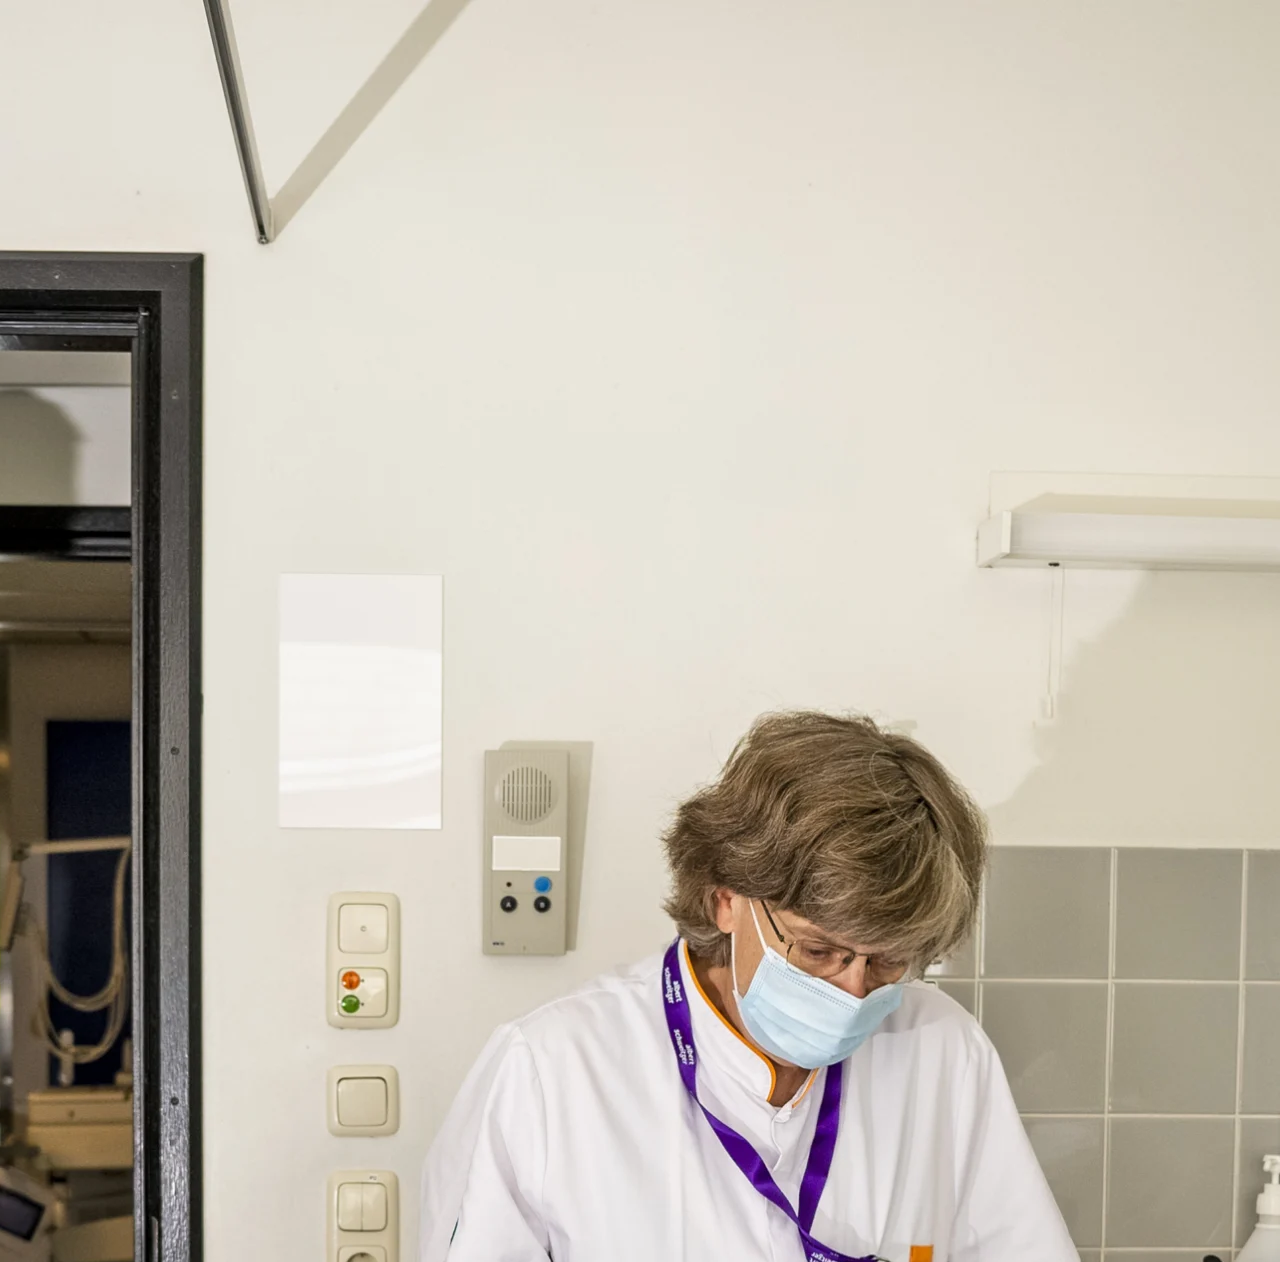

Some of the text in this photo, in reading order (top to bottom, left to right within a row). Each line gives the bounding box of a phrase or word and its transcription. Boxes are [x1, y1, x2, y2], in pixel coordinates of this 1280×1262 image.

[664, 968, 674, 1003] schweitzer
[673, 981, 682, 1002] albert
[674, 1029, 687, 1065] schweitzer
[685, 1045, 694, 1065] albert
